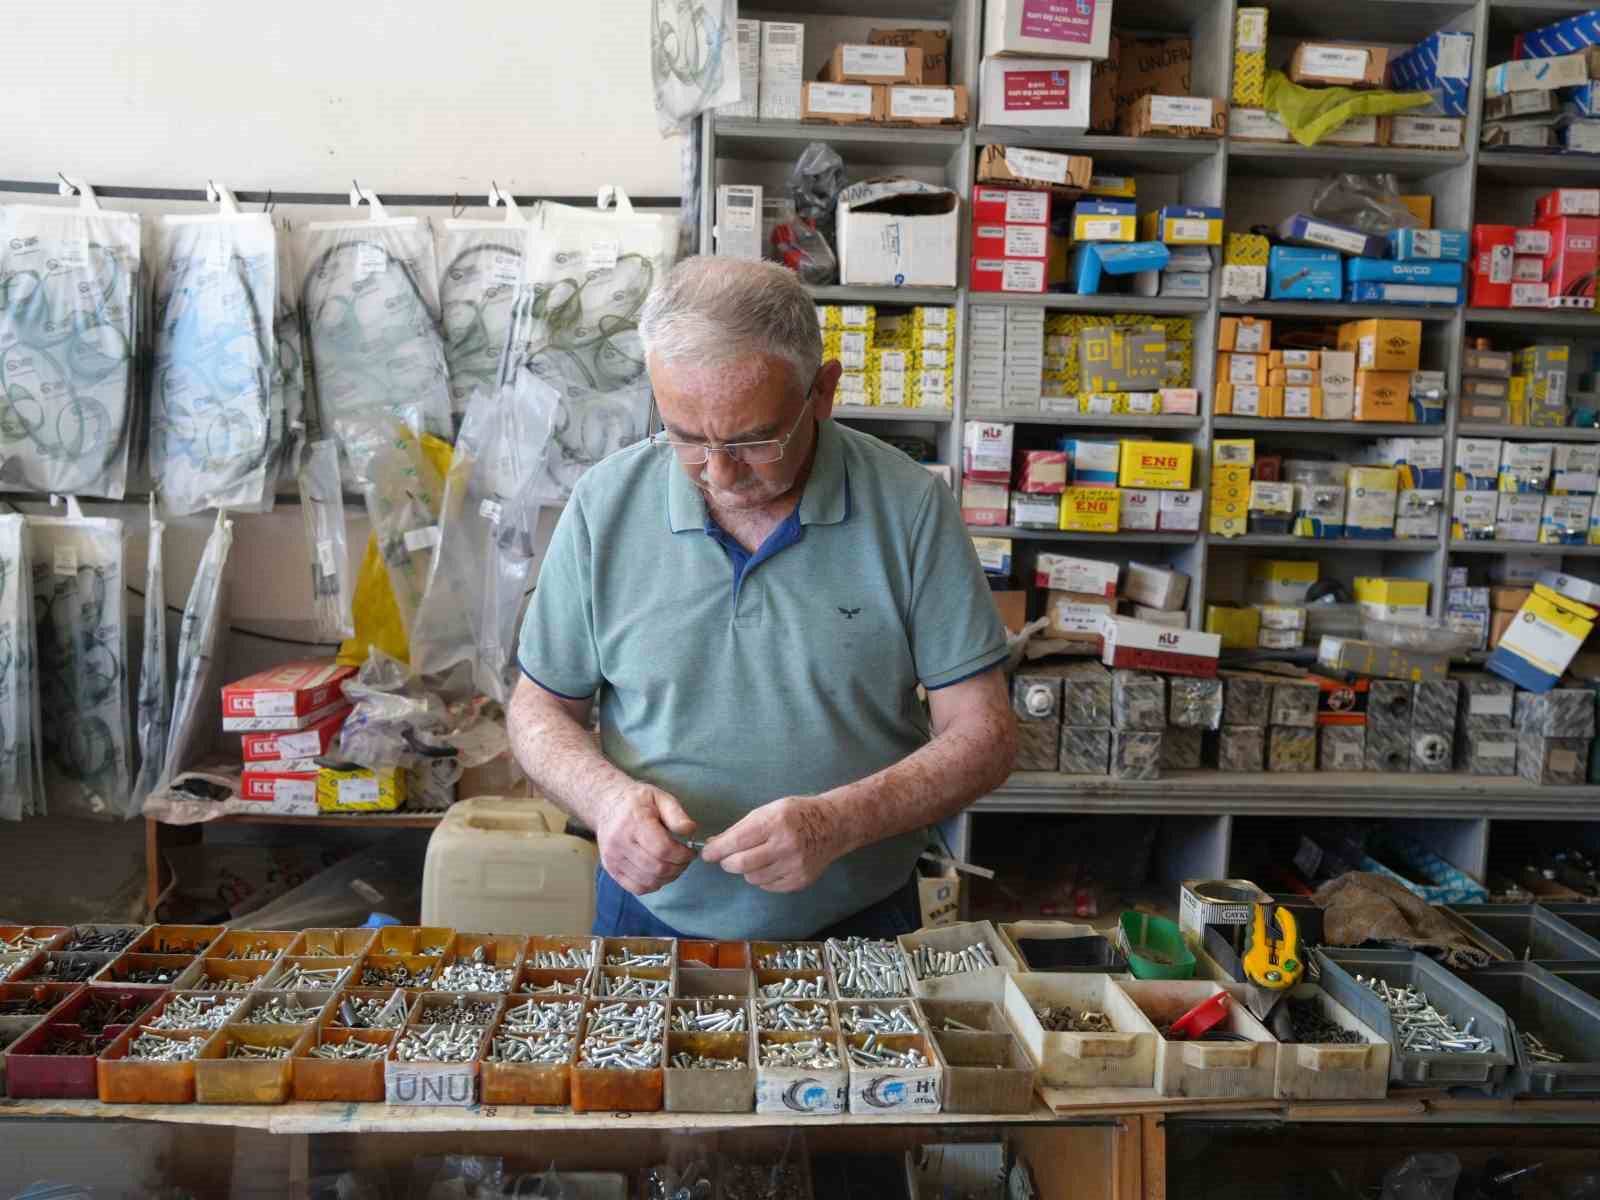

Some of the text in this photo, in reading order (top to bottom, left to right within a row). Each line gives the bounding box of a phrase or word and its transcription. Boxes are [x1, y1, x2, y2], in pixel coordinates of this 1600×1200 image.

[1141, 456, 1178, 467] ENG
[1076, 501, 1109, 512] ENG
[233, 697, 256, 710] KK
[253, 781, 275, 794] KK
